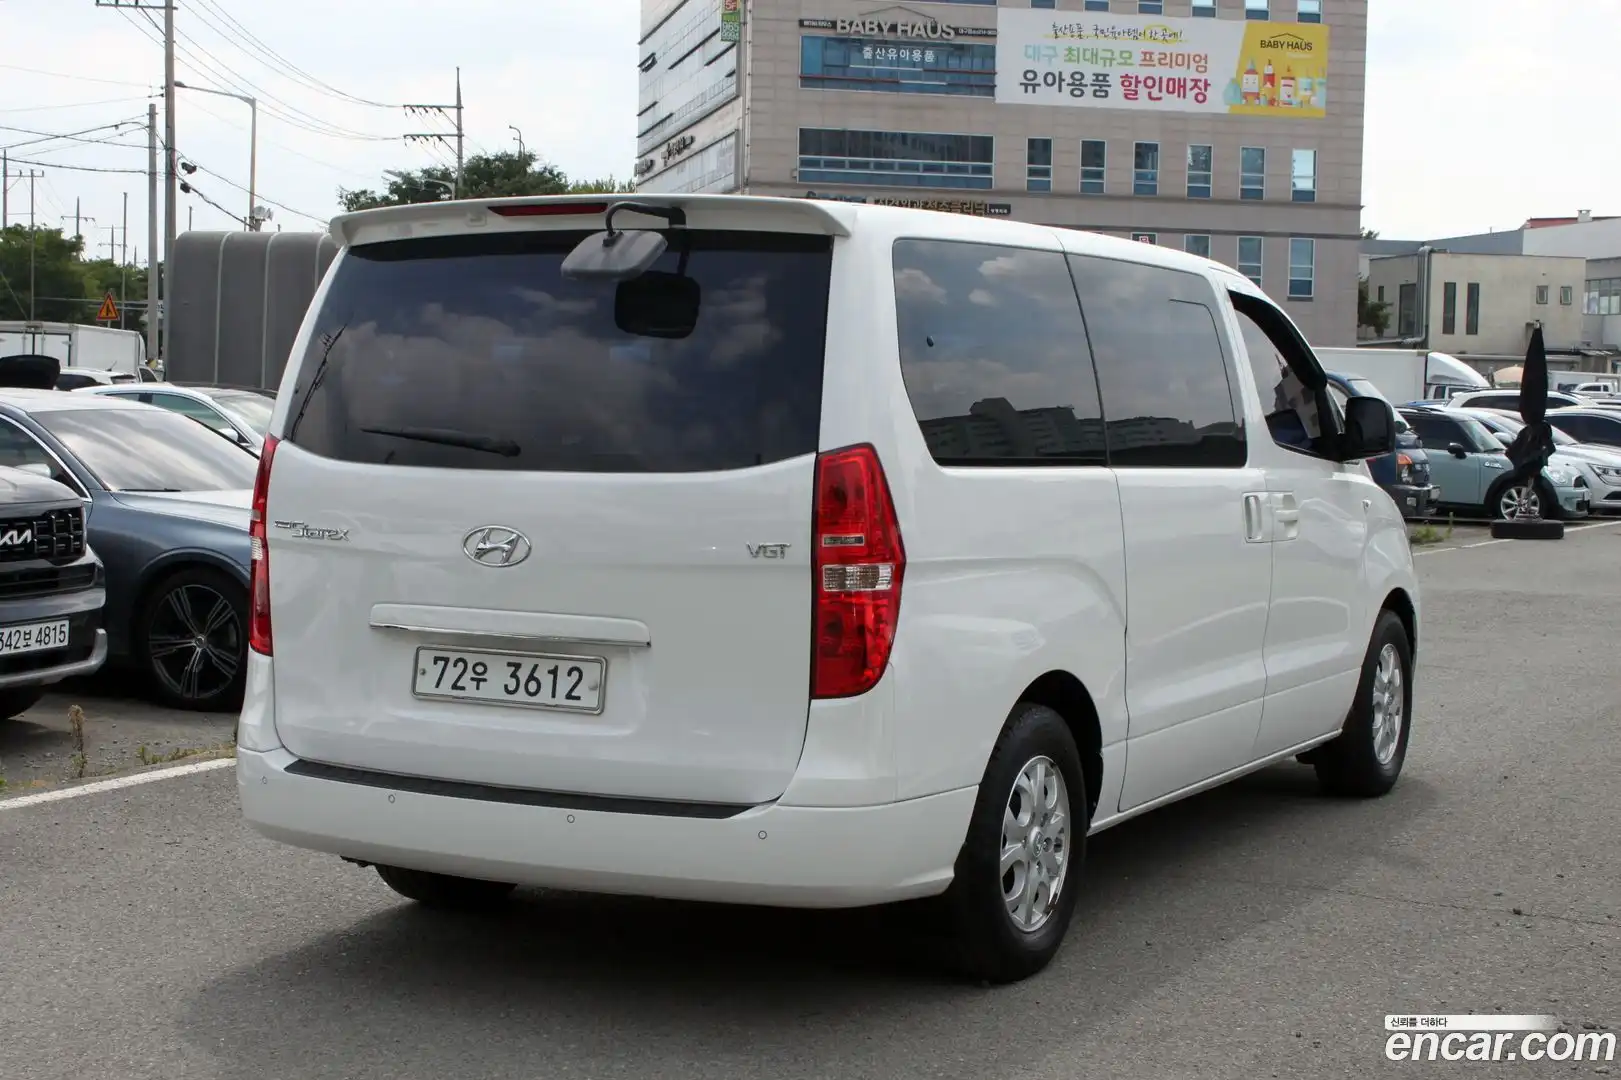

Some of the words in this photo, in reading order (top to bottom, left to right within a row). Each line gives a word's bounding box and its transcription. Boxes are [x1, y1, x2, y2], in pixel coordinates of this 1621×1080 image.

[836, 18, 891, 36] BABY
[896, 21, 955, 40] HAUS
[862, 46, 935, 62] 출산유아용품
[1260, 40, 1285, 50] BABY
[1286, 40, 1313, 51] HAUS
[1024, 44, 1058, 66] 대구
[1063, 46, 1135, 67] 최대규모
[1138, 50, 1208, 73] 프리미엄
[1020, 69, 1112, 98] 유아용품
[1119, 73, 1211, 103] 할인매장
[274, 520, 351, 542] Starex
[746, 542, 791, 559] VGT
[35, 623, 66, 646] 4815
[433, 656, 488, 691] 72우
[503, 661, 583, 701] 3612
